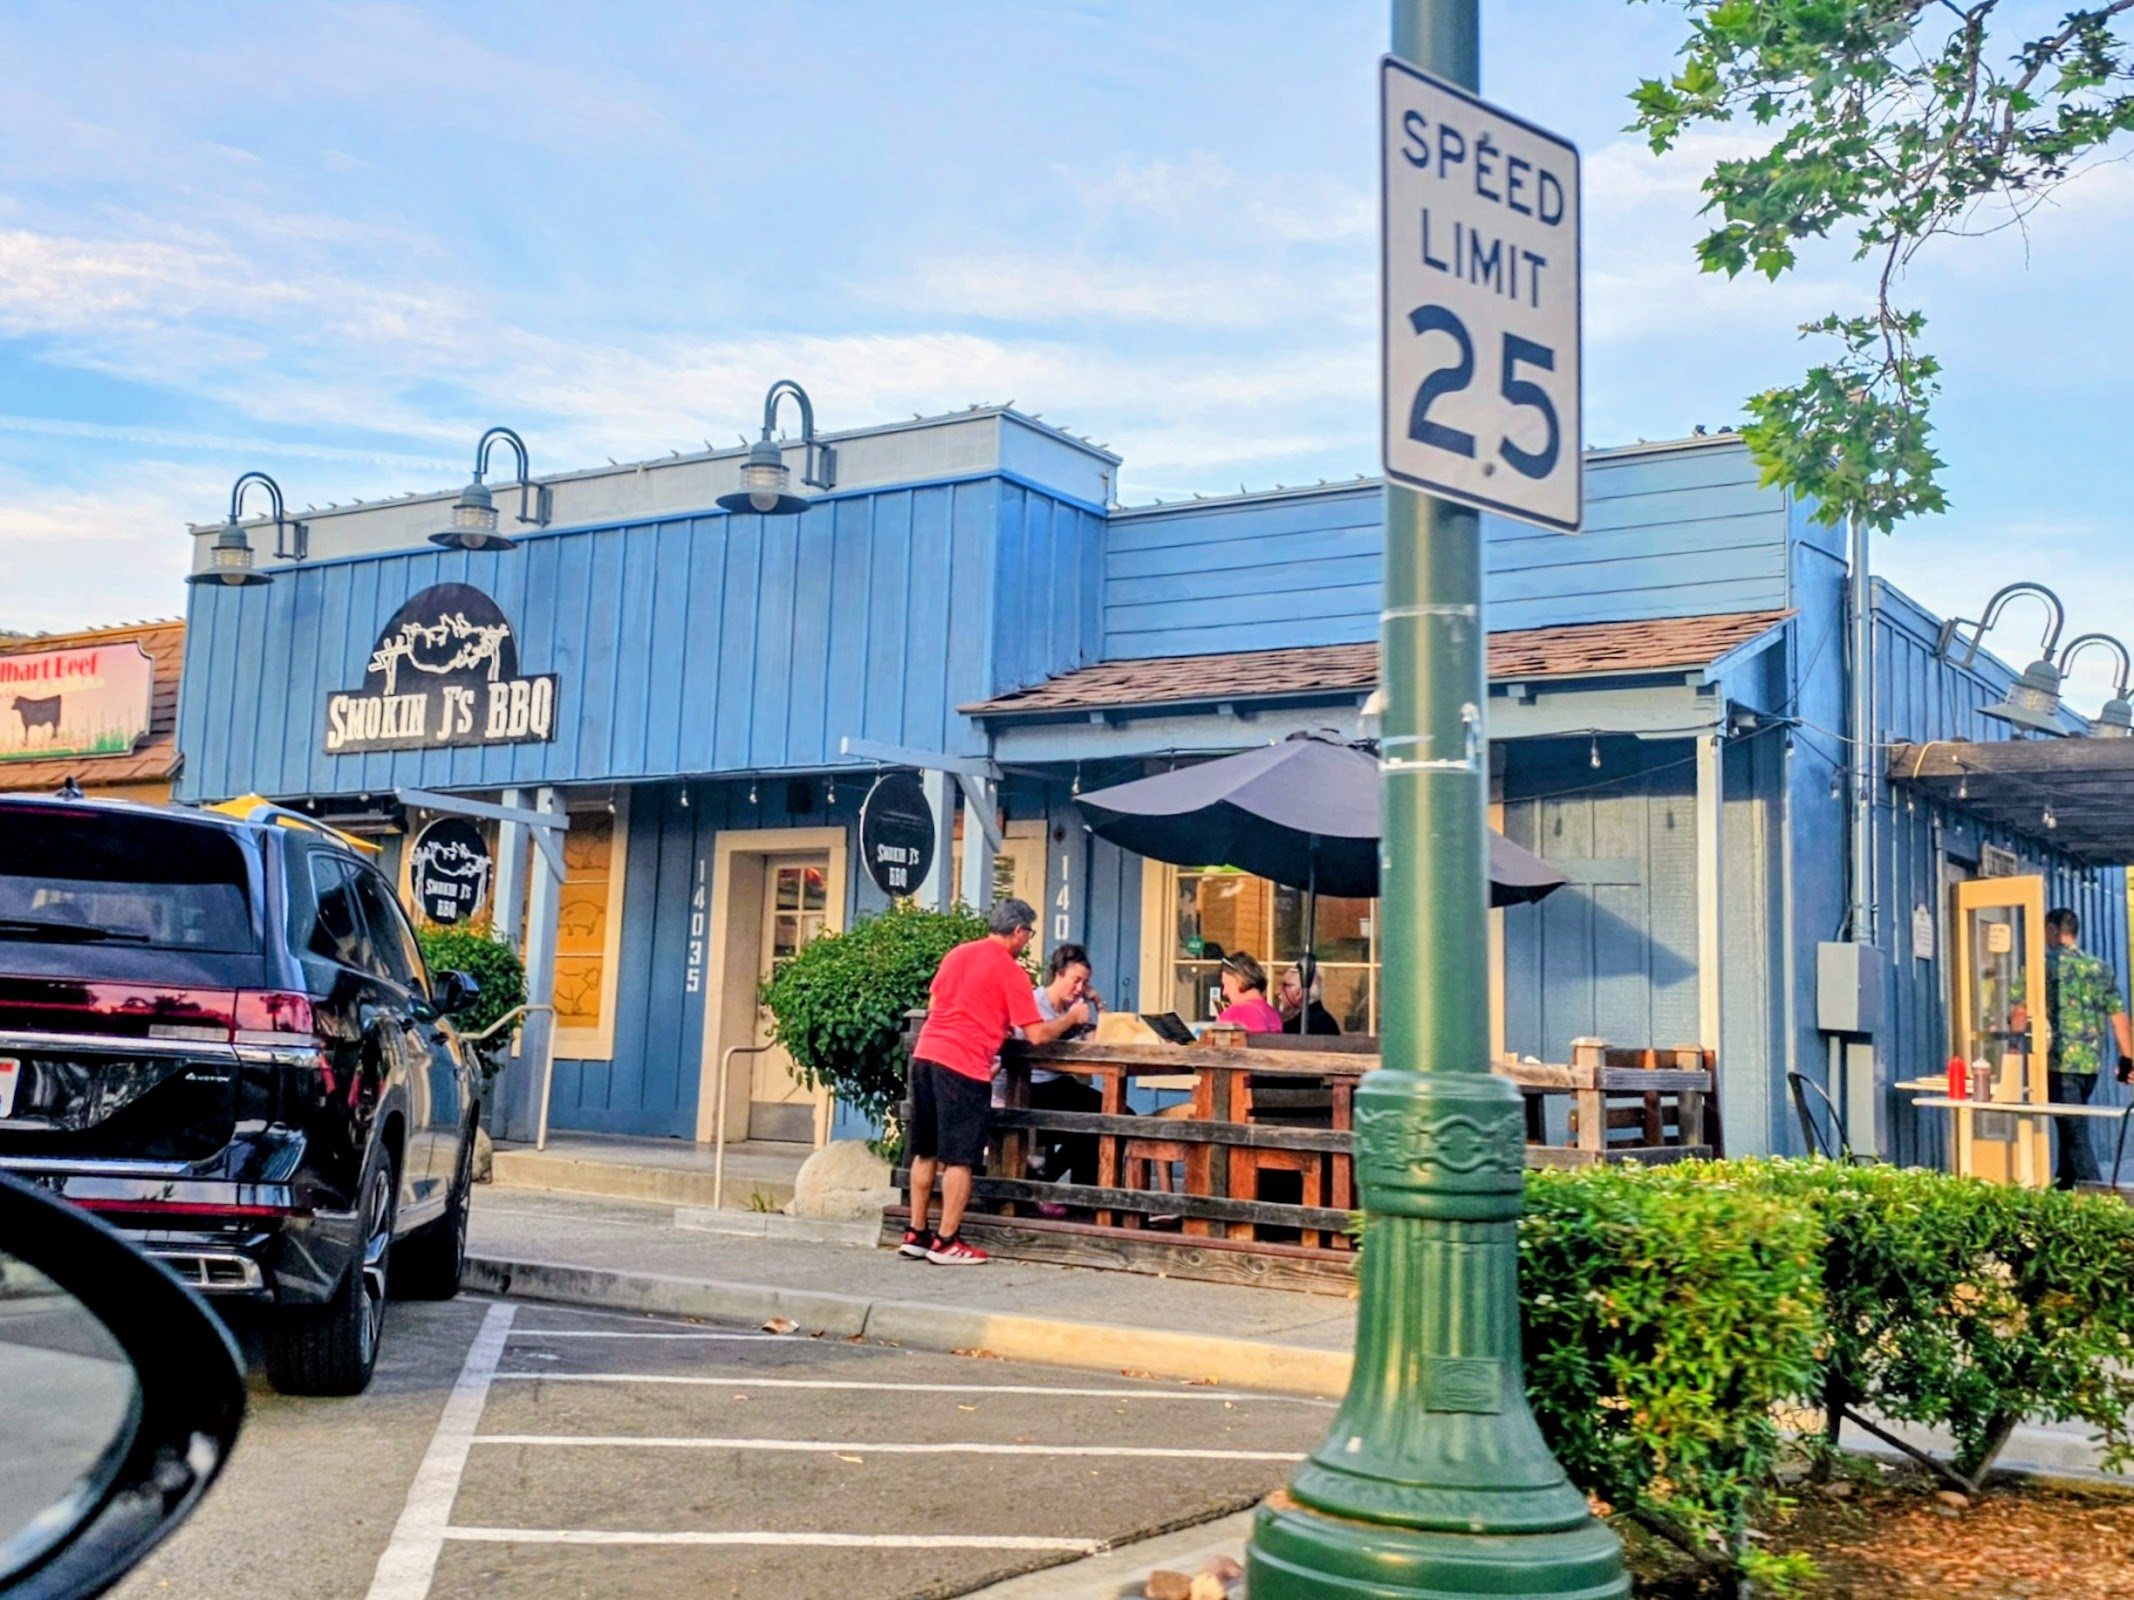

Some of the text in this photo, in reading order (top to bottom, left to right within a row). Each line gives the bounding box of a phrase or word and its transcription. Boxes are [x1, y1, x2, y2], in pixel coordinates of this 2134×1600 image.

[1401, 109, 1565, 227] SPEED
[1421, 207, 1549, 309] LIMIT
[1407, 304, 1561, 480] 25
[484, 676, 553, 739] BBQ
[436, 898, 458, 920] BBQ
[686, 859, 706, 993] 14035
[888, 866, 908, 888] BBQ
[1055, 854, 1070, 949] 140
